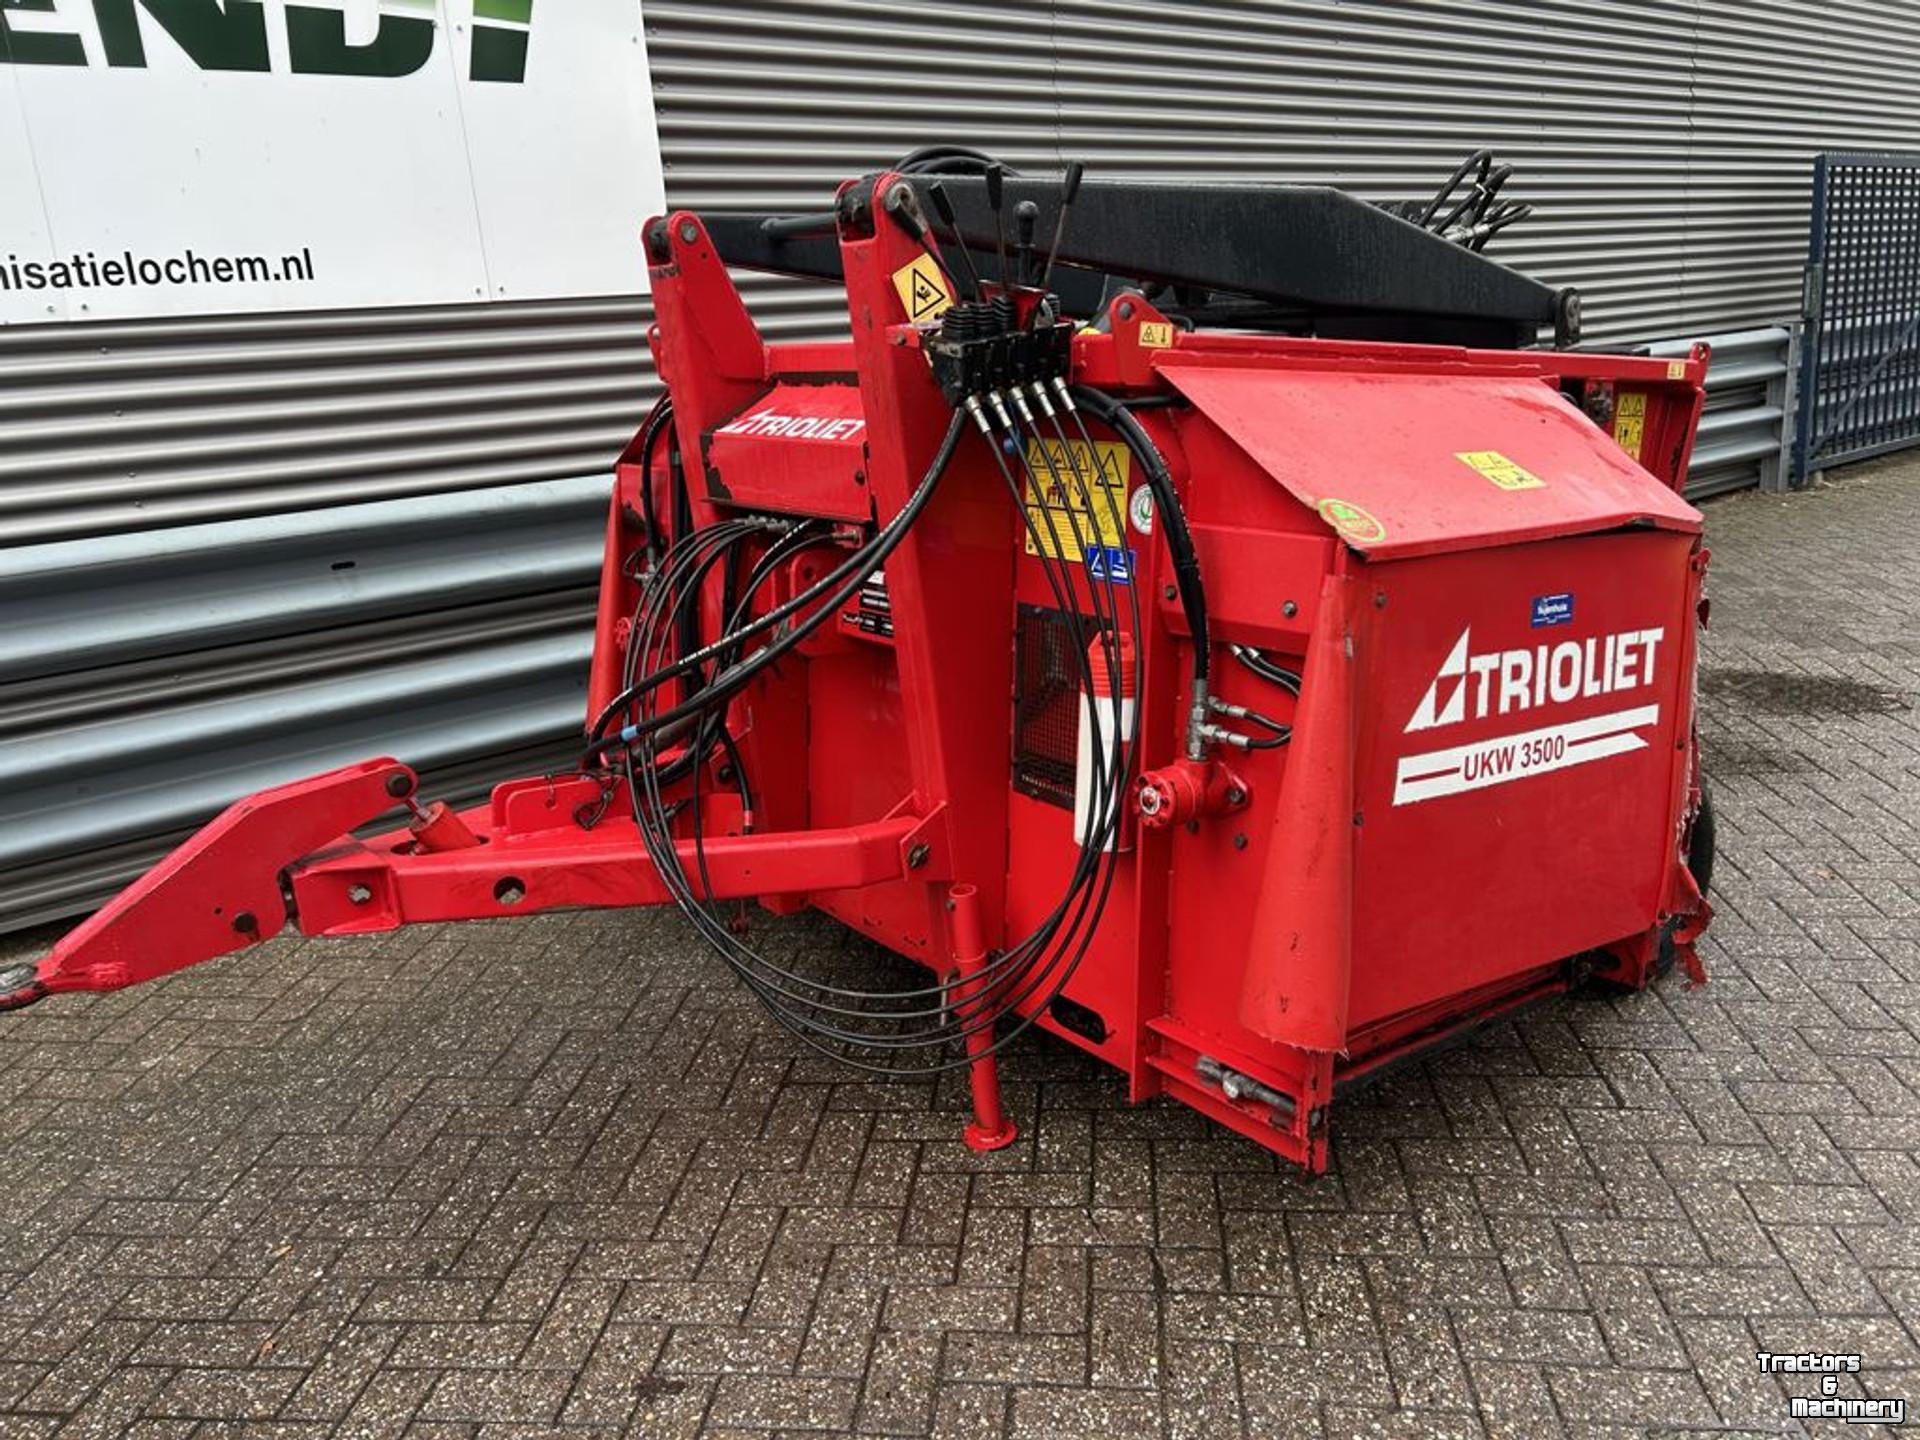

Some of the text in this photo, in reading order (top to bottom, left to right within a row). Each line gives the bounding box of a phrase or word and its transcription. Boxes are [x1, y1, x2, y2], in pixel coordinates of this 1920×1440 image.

[746, 415, 866, 440] TRIOLIET
[1470, 627, 1664, 719] TRIOLIET
[1463, 734, 1565, 781] UKW 3500
